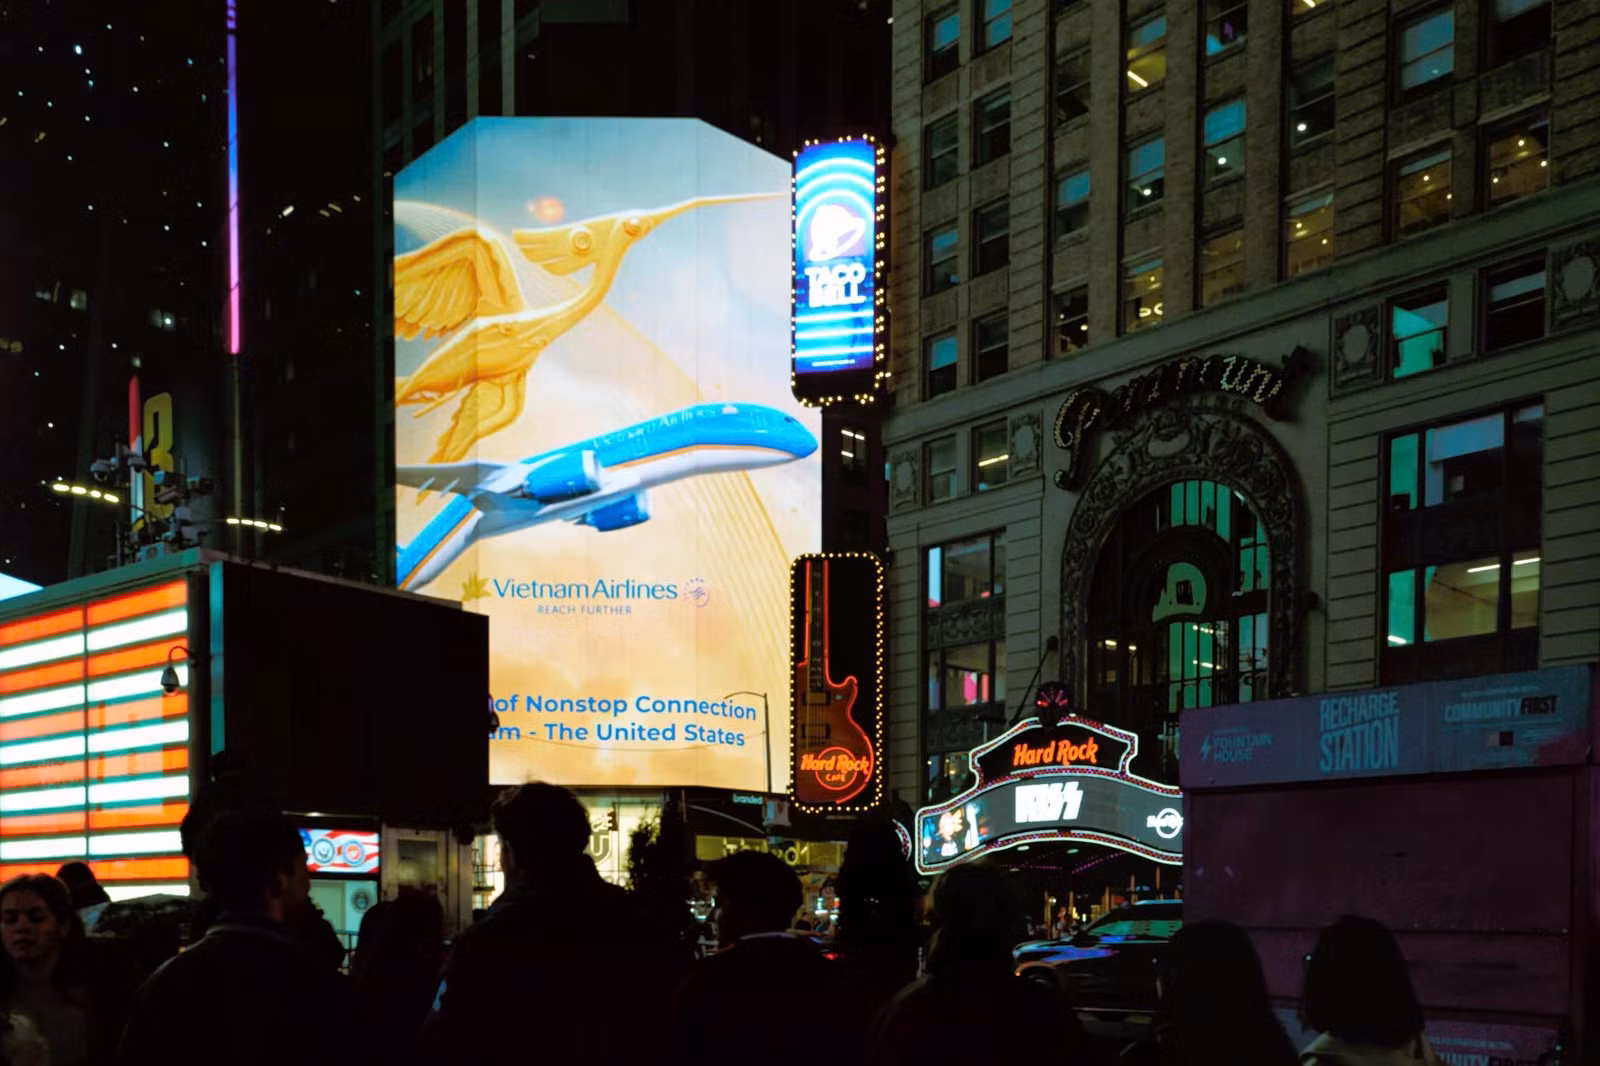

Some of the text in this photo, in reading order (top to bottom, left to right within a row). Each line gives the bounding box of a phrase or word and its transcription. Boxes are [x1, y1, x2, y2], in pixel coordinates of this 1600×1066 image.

[804, 263, 866, 285] TACO
[493, 578, 678, 599] Vietnam Airlines
[581, 605, 632, 615] FURTHER
[495, 694, 757, 721] of Nonstop Connection
[1320, 692, 1399, 731] RECHARGE
[544, 722, 589, 740] The
[596, 722, 676, 740] United
[684, 724, 746, 746] States
[1320, 718, 1399, 774] STATION
[1013, 737, 1098, 766] Hard Rock
[800, 753, 870, 775] Hard Rock
